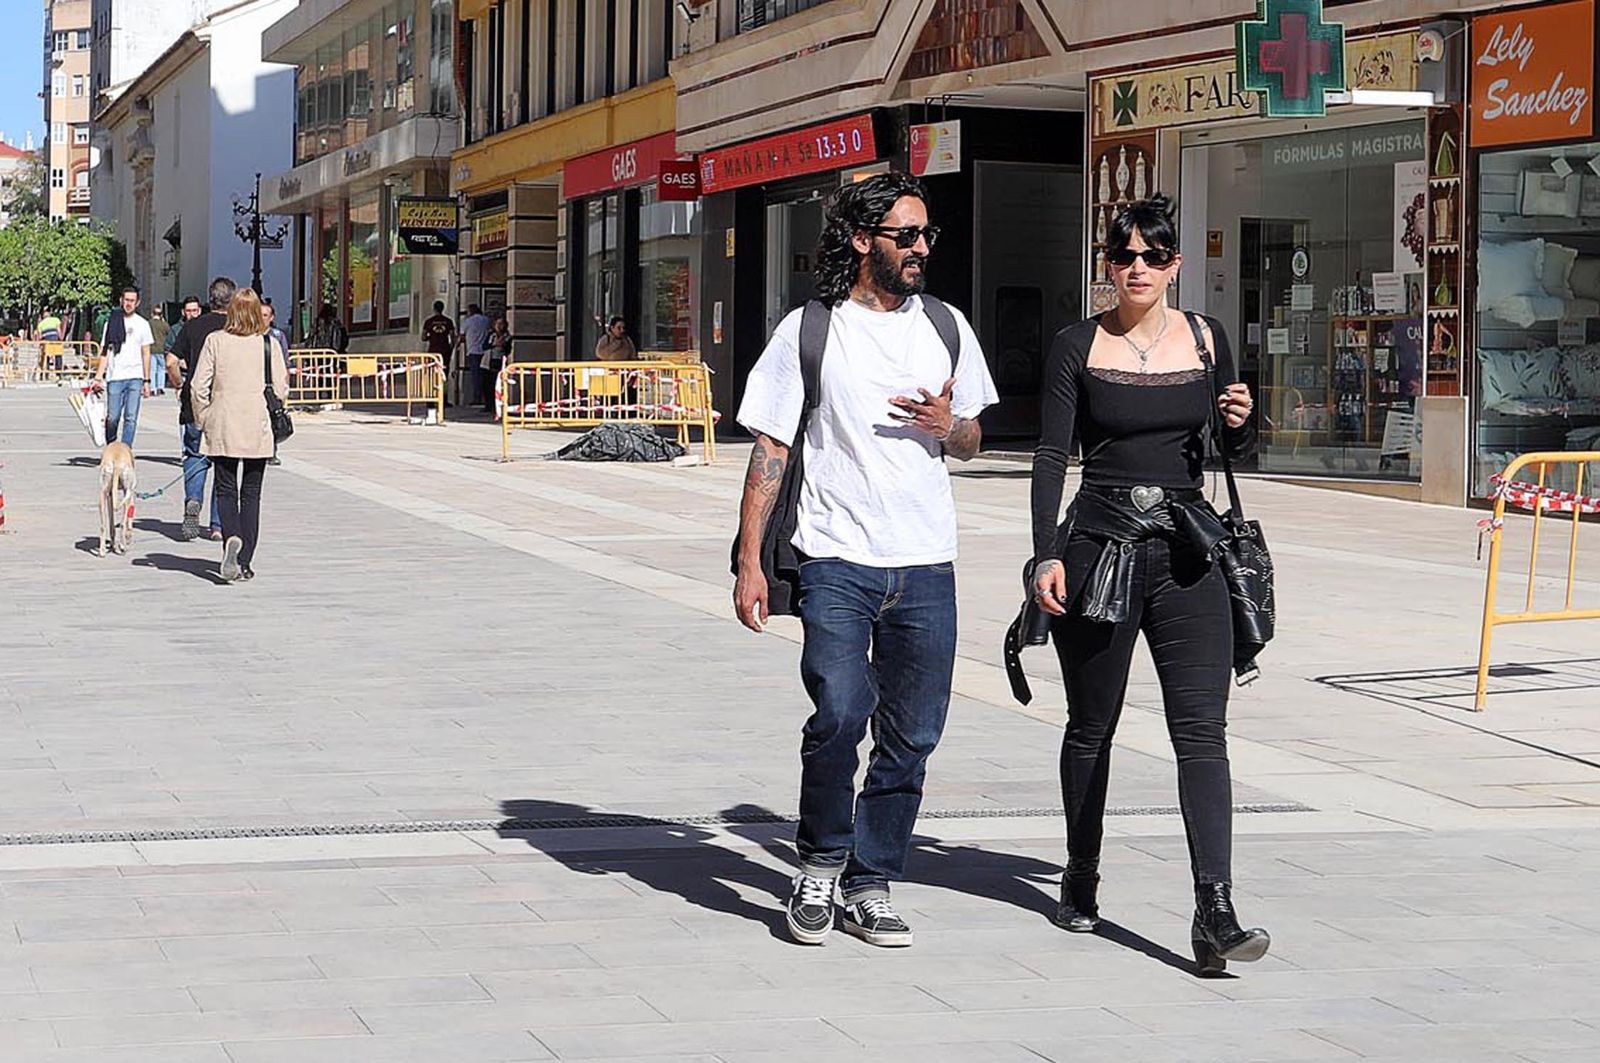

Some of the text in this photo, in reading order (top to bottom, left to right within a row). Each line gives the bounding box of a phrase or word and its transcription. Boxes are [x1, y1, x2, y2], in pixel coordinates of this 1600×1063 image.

[1476, 22, 1535, 72] Lely
[1184, 70, 1254, 113] FAR
[1483, 71, 1588, 125] Sanchez
[1351, 131, 1426, 157] MAGISTRA
[611, 148, 637, 182] GAES
[662, 173, 696, 185] GAES
